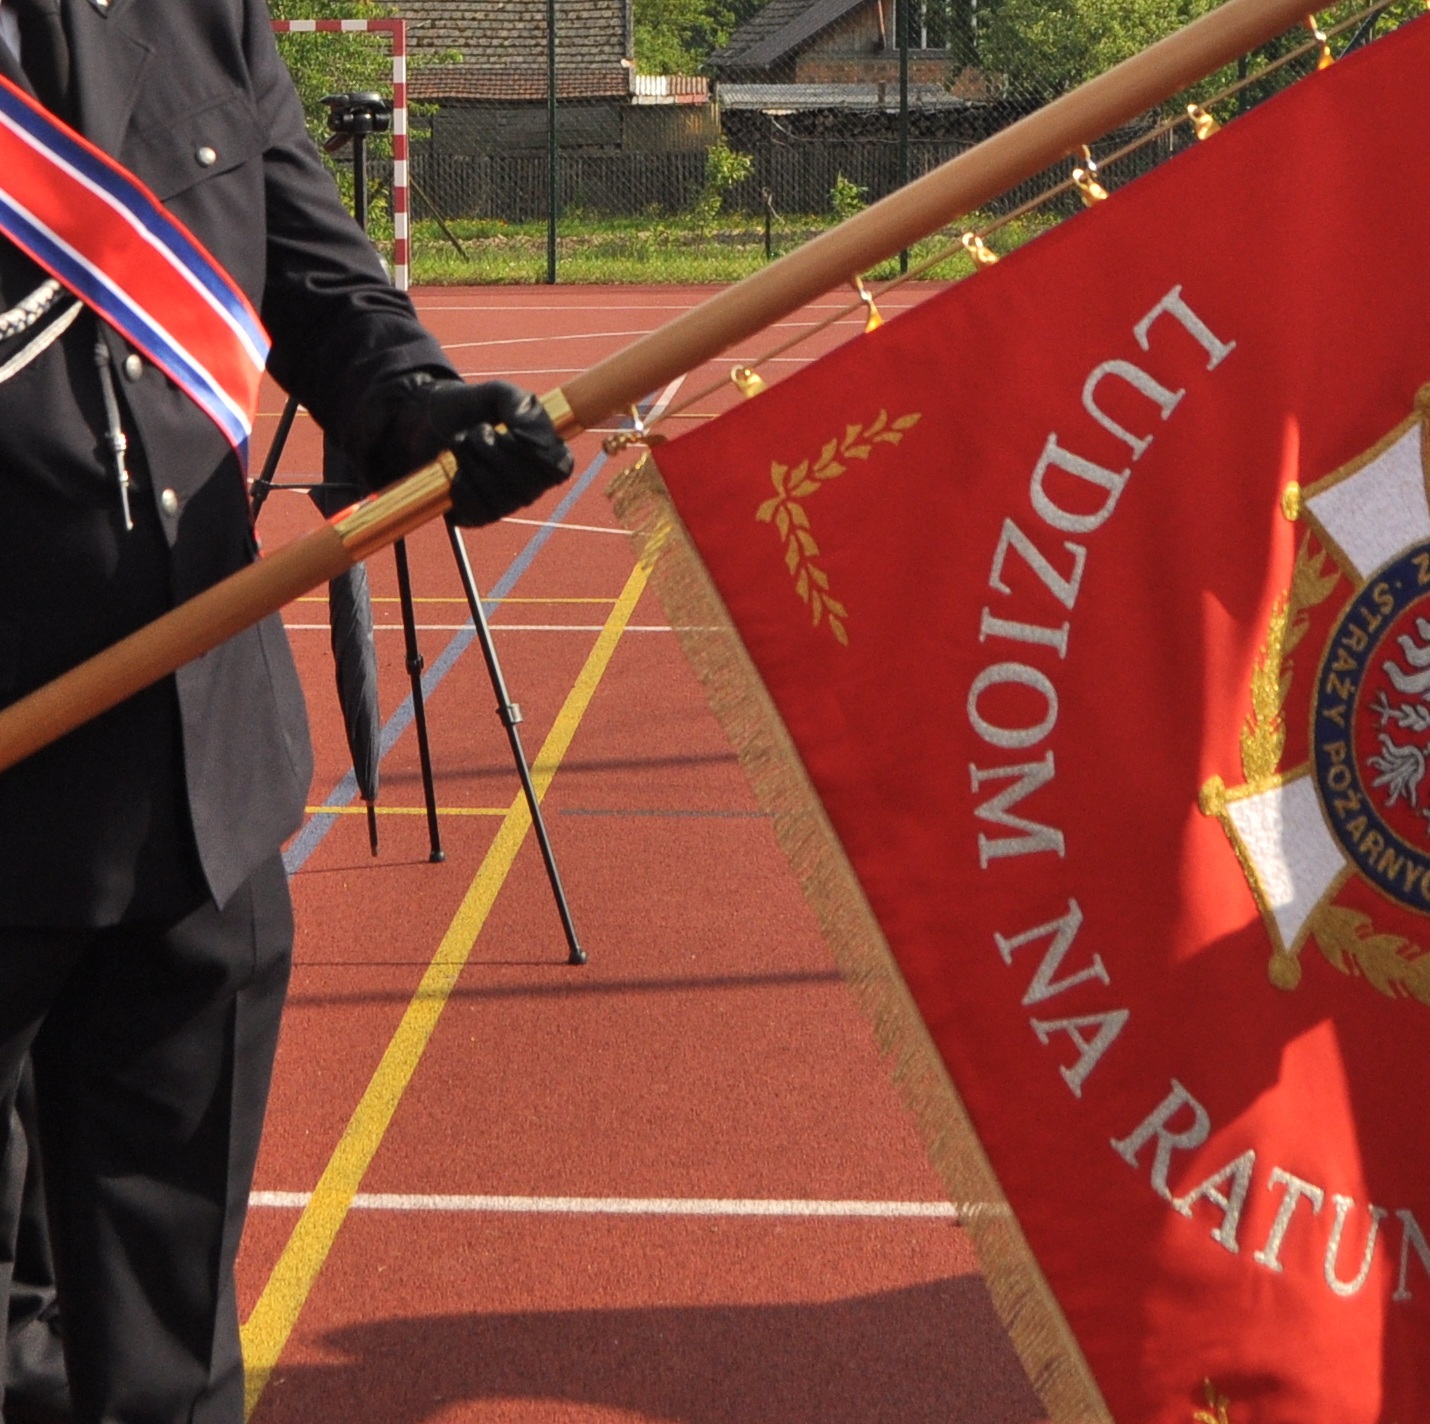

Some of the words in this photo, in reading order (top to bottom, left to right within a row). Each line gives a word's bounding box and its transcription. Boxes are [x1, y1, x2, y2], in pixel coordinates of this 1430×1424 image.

[966, 283, 1237, 869] LUDZIOM
[1321, 580, 1395, 729] STRAŻY
[993, 897, 1130, 1098] NA
